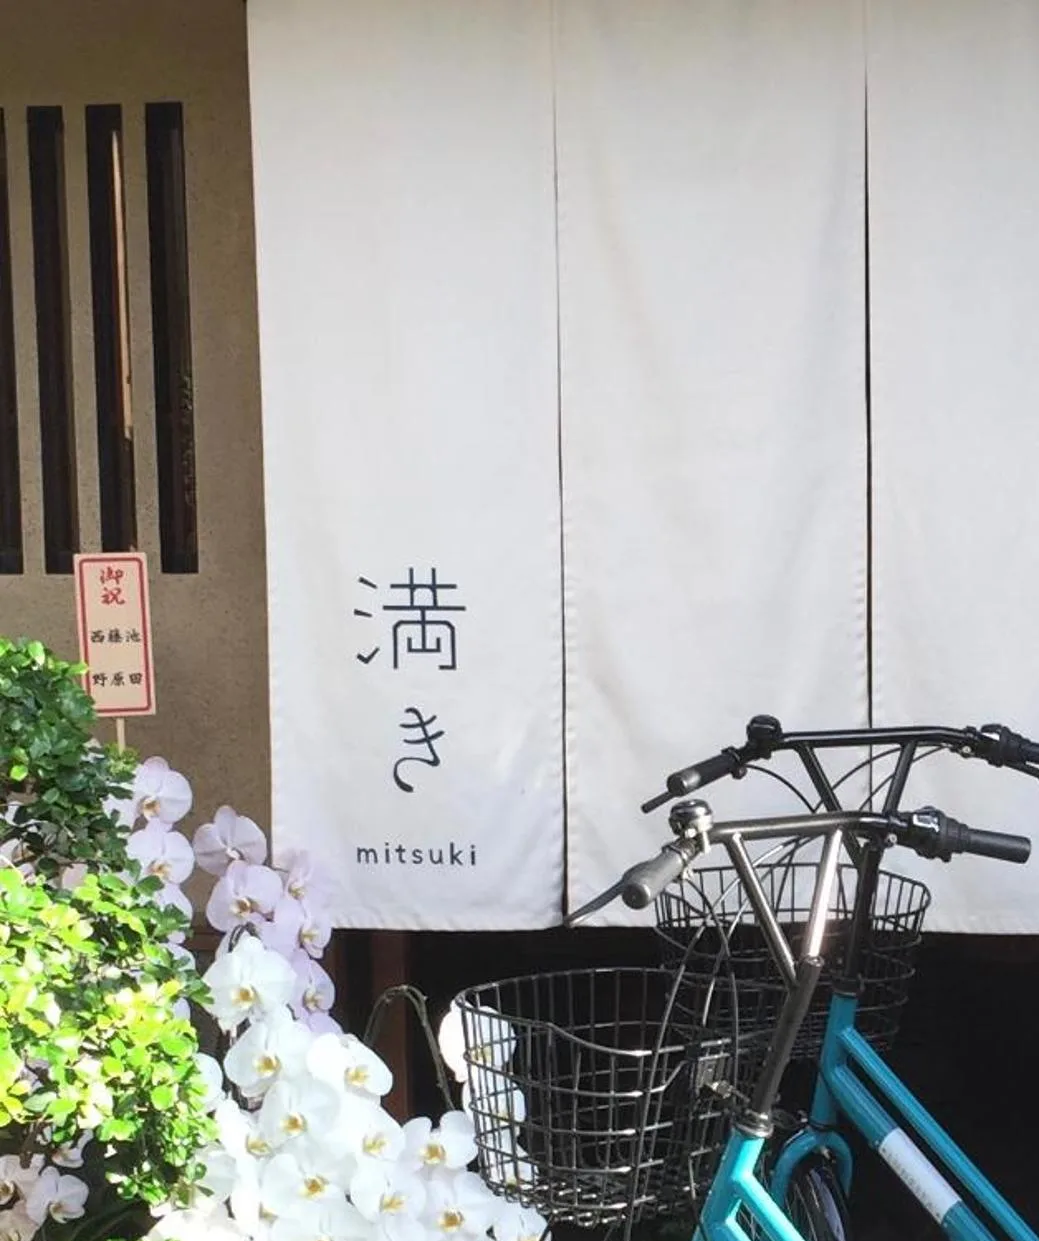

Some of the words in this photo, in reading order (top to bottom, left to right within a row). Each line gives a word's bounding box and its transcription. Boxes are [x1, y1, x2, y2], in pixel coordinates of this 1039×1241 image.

[99, 566, 126, 605] 御祝
[353, 567, 466, 792] 満き
[356, 842, 476, 866] mitsuki
